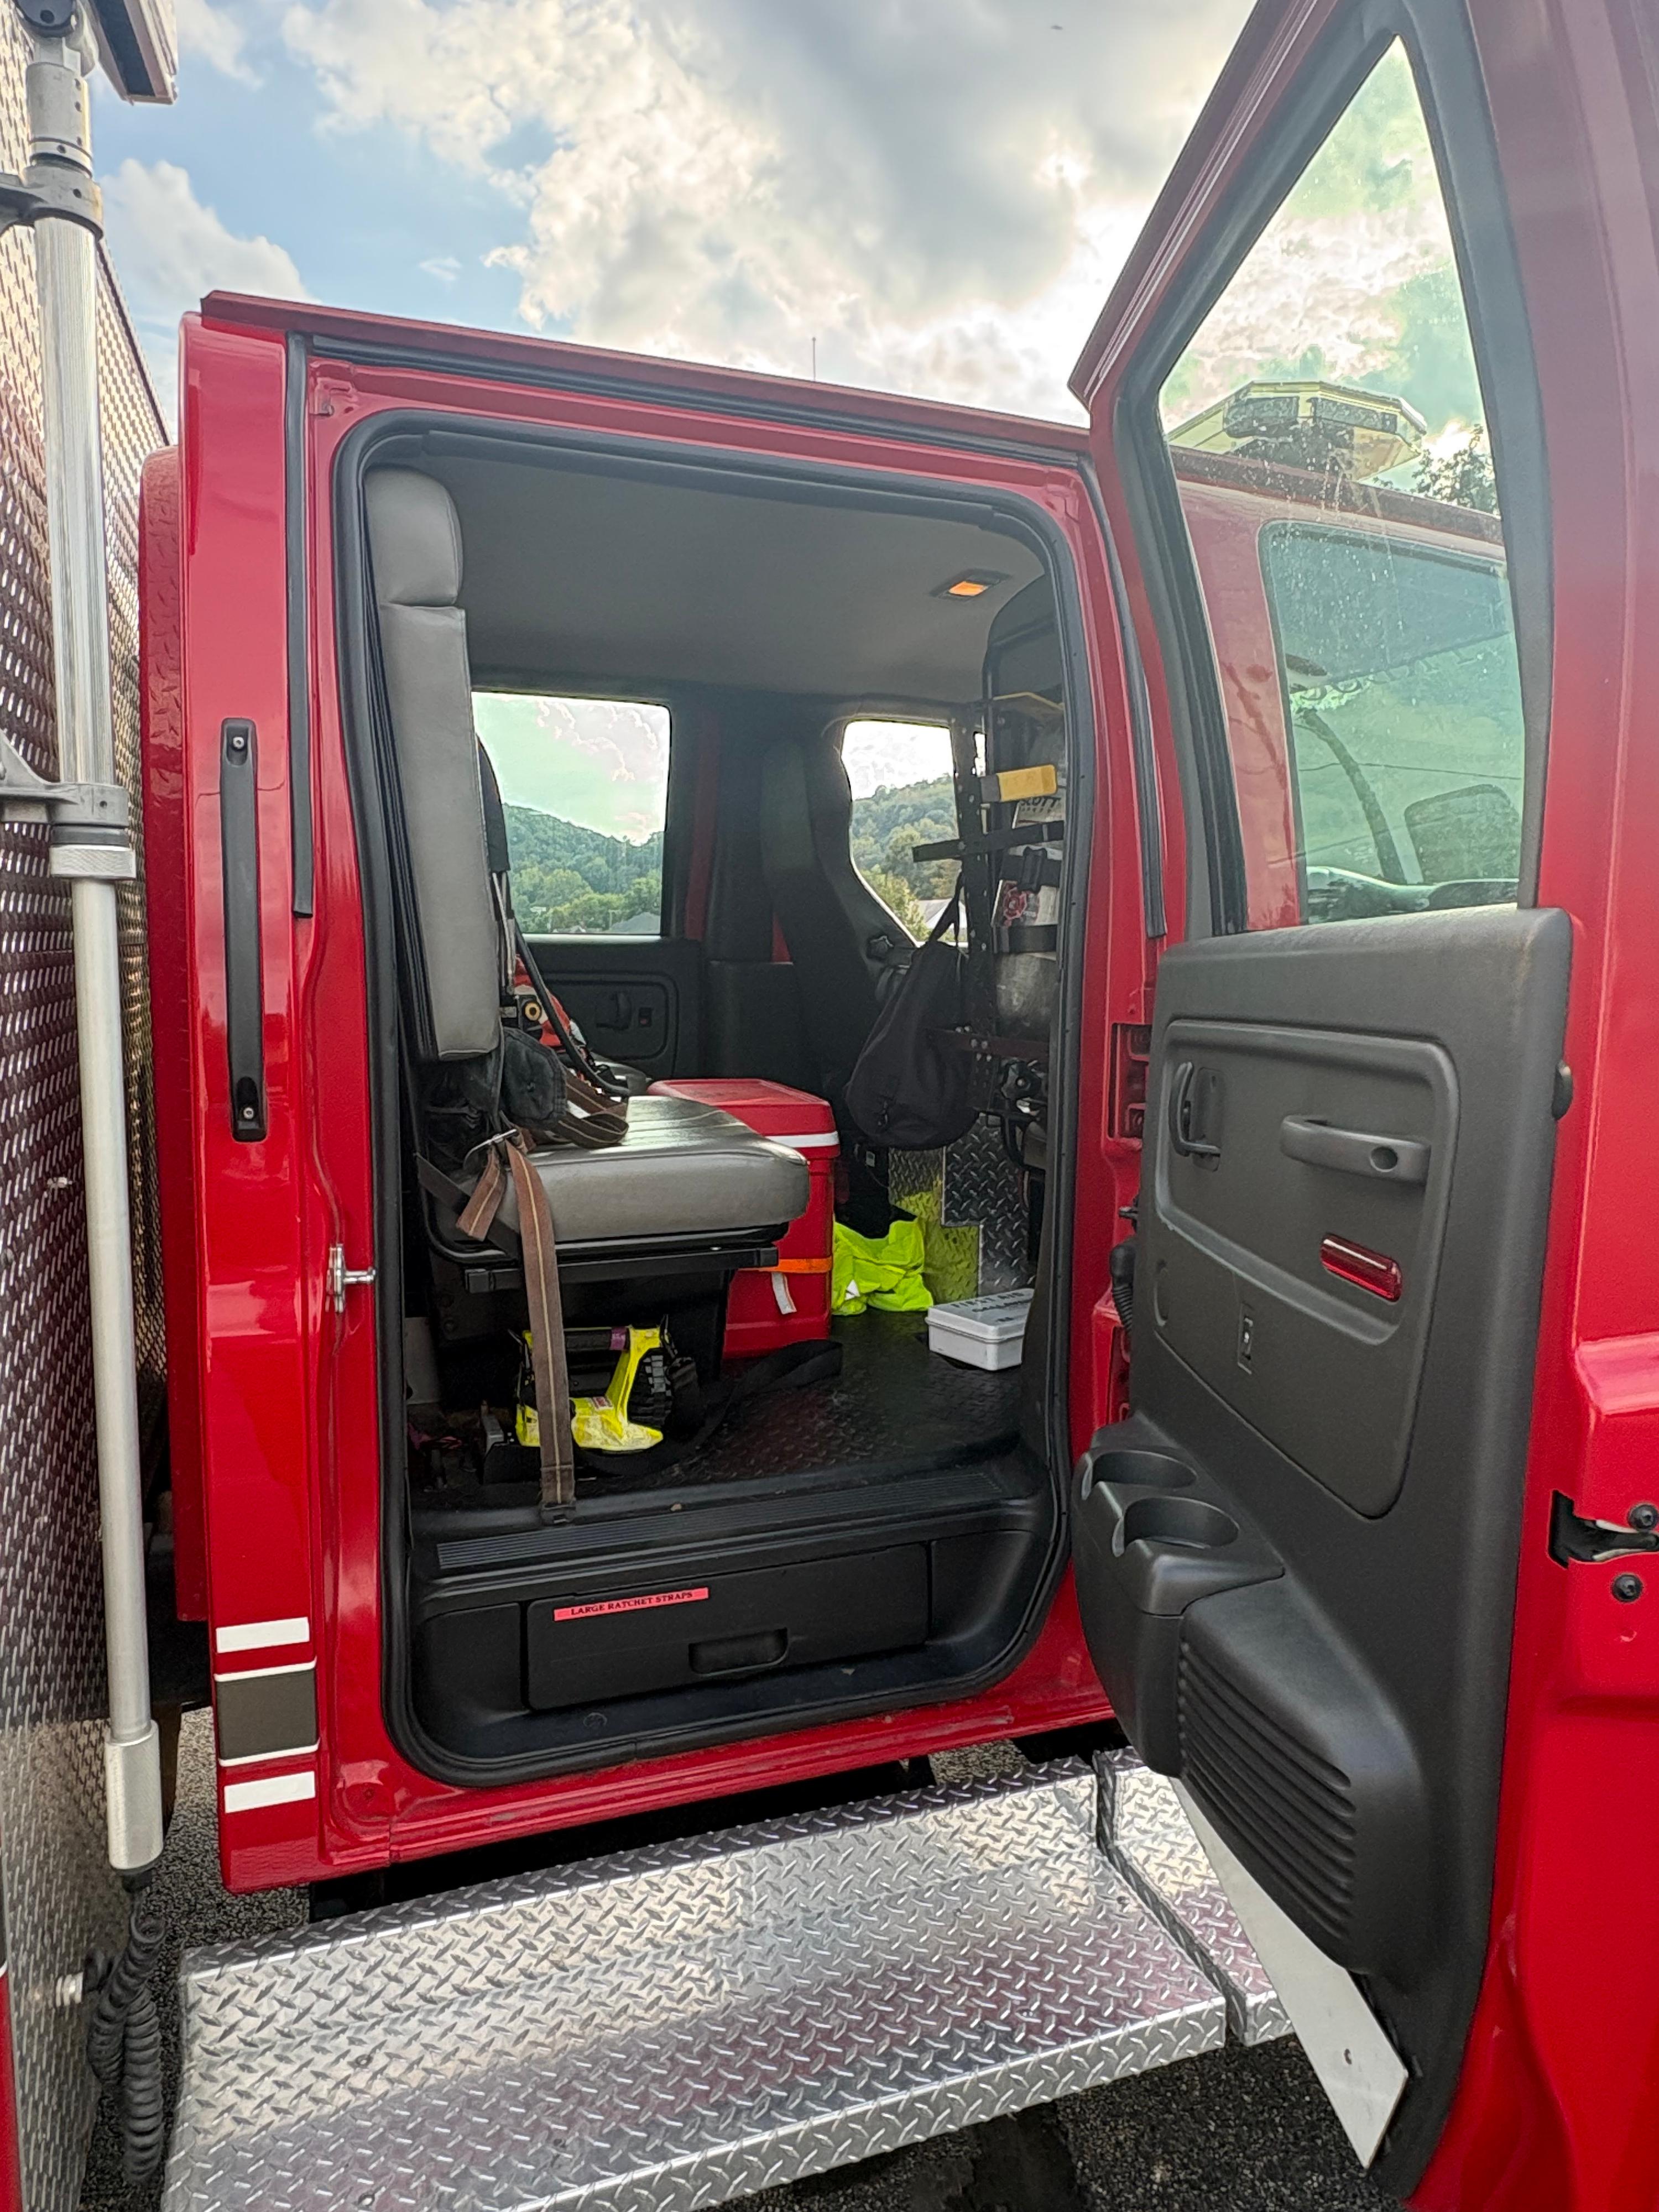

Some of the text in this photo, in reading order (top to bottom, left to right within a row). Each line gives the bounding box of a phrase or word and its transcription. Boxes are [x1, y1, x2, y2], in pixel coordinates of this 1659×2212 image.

[571, 1592, 692, 1615] LARGE RATCHET STRAPS
